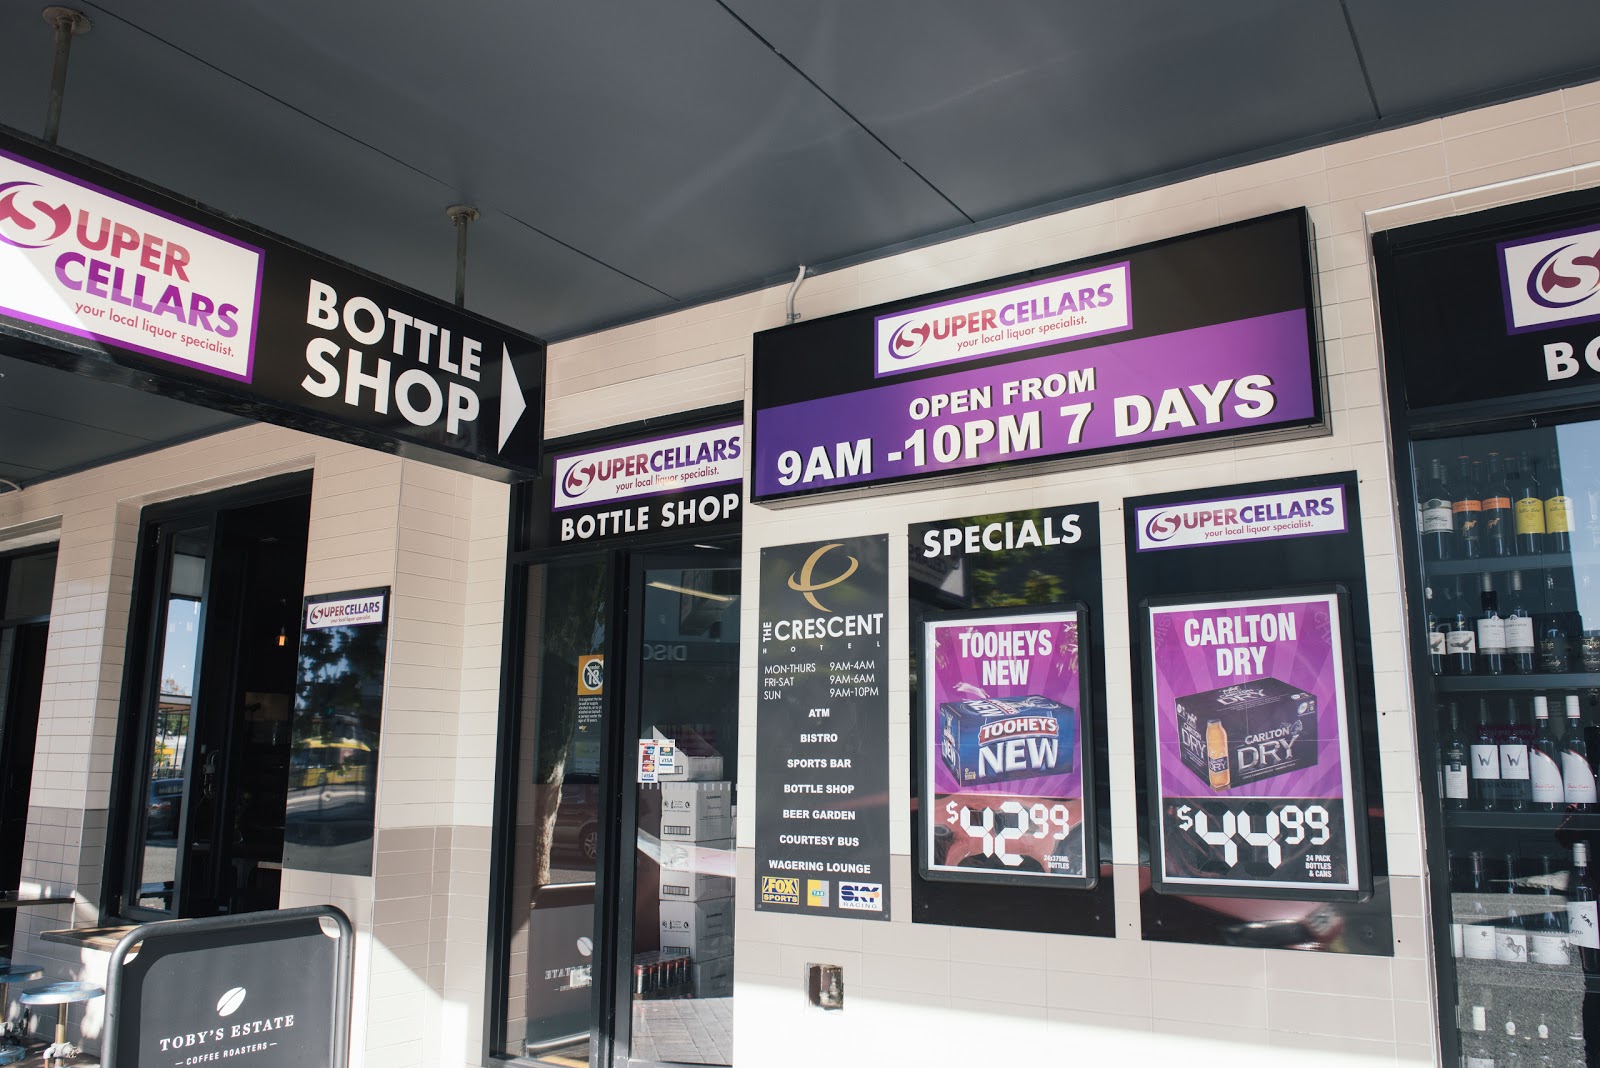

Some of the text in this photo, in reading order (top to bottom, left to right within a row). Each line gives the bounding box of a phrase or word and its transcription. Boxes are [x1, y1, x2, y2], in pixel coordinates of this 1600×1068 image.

[0, 187, 191, 283] SUPER
[54, 251, 239, 338] CELLARS
[75, 300, 235, 357] your local liquor specialist.
[306, 278, 483, 382] BOTTLE
[889, 283, 1114, 358] SUPERCELLARS
[957, 316, 1088, 352] your local liquor specialist.
[301, 337, 481, 436] SHOP
[907, 367, 1097, 422] OPEN FROM
[776, 437, 874, 487] 9AM
[1059, 403, 1095, 446] 7
[1113, 374, 1277, 439] DAYS
[563, 436, 741, 496] SUPERCELLARS
[616, 466, 720, 494] your local liquor specialist.
[561, 493, 739, 542] BOTTLE SHOP
[1146, 496, 1335, 541] SUPERCELLARS
[1204, 519, 1314, 539] your local liquor specialist.
[923, 513, 1082, 558] SPECIALS
[763, 621, 772, 643] THE
[774, 613, 884, 641] CRESCENT
[1184, 612, 1297, 647] CARLTON
[958, 629, 1052, 658] TOOHEYS
[764, 660, 875, 674] MON-THURS 9AM-4AM
[982, 659, 1029, 686] NEW
[1216, 646, 1267, 677] DRY
[763, 686, 879, 700] SUN 9AM-10PM
[764, 674, 875, 687] FRI-SAT 9AM-6AM
[808, 708, 830, 718] ATM
[800, 733, 838, 743] BISTRO
[983, 718, 1057, 739] TOOHEYS
[1245, 726, 1290, 745] CARLTON
[787, 758, 852, 769] SPORTS BAR
[978, 738, 1059, 778] NEW
[1237, 734, 1300, 772] DRY
[784, 784, 855, 794] BOTTLE SHOP
[783, 809, 856, 820] BEER GARDEN
[779, 835, 860, 847] COURTESY BUS
[769, 859, 871, 874] WAGERING LOUNGE
[1048, 862, 1069, 870] BOTTLES
[1305, 854, 1331, 863] 24 PACK
[1305, 862, 1332, 870] BOTTLES
[768, 878, 794, 894] FOX
[1315, 870, 1332, 878] CANS
[763, 894, 798, 903] SPORTS
[160, 1014, 295, 1052] TOBY'S ESTATE
[186, 1042, 268, 1066] COFFEE ROASTERS
